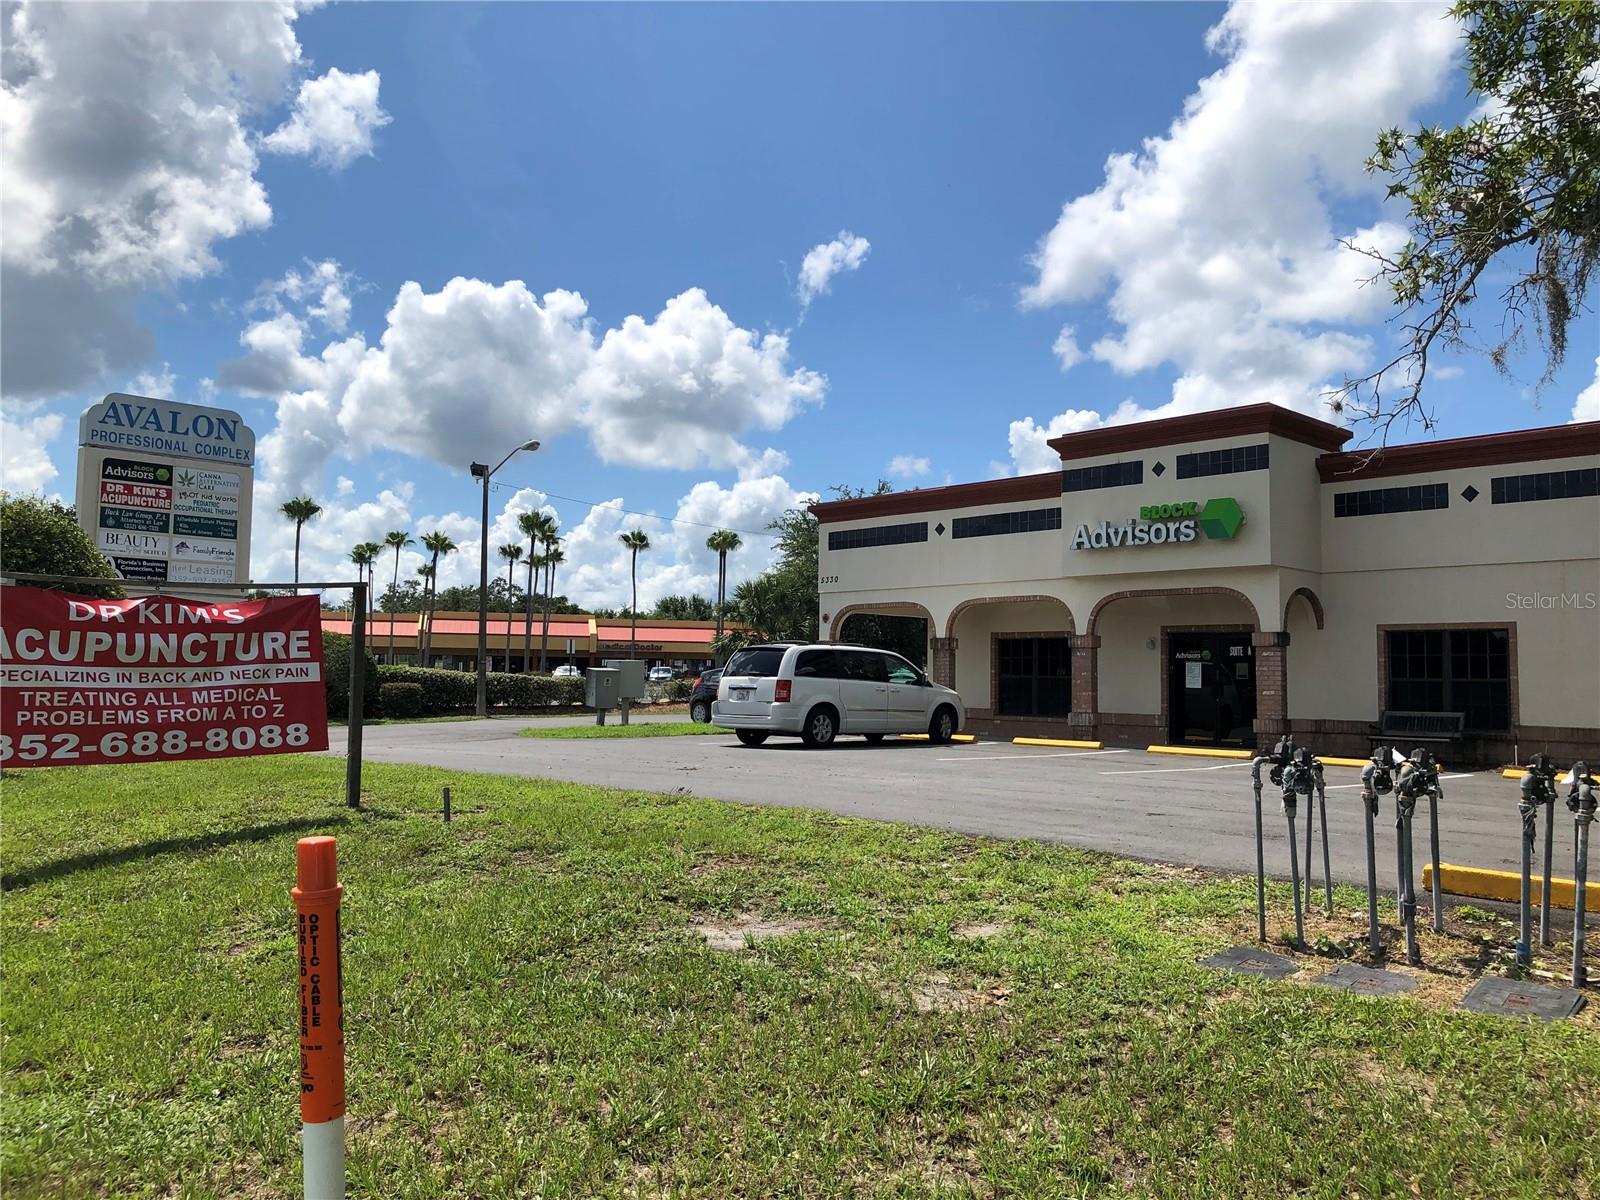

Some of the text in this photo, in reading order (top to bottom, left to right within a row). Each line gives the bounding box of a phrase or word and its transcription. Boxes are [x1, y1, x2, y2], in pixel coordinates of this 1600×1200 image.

[98, 401, 239, 442] AVALON
[91, 429, 250, 461] PROFESSIONAL COMPLEX
[104, 465, 155, 480] Advisors
[199, 471, 222, 480] CANNA
[106, 483, 167, 498] DR. KIM'S
[101, 493, 171, 509] ACUPUNCTURE
[193, 500, 220, 508] PEDIATRIC
[174, 504, 238, 516] OCCUPATIONAL THERAPY
[1140, 501, 1198, 520] BLOCK
[105, 532, 160, 548] BEAUTY
[1070, 518, 1197, 550] Advisors
[189, 564, 233, 578] Leasing
[820, 575, 839, 584] 5330
[68, 600, 245, 625] DR KIM'S
[634, 643, 663, 651] Doctor
[1229, 645, 1252, 657] SUITE A
[116, 672, 133, 684] IN
[138, 671, 187, 684] BACK
[190, 670, 225, 683] AND
[229, 668, 272, 681] NECK
[275, 667, 310, 679] PAIN
[19, 687, 282, 707] TREATING ALL MEDICAL
[16, 703, 285, 727] PROBLEMS FROM A TO Z
[299, 913, 308, 976] BURIED
[308, 913, 321, 1027] OPTIC CABLE
